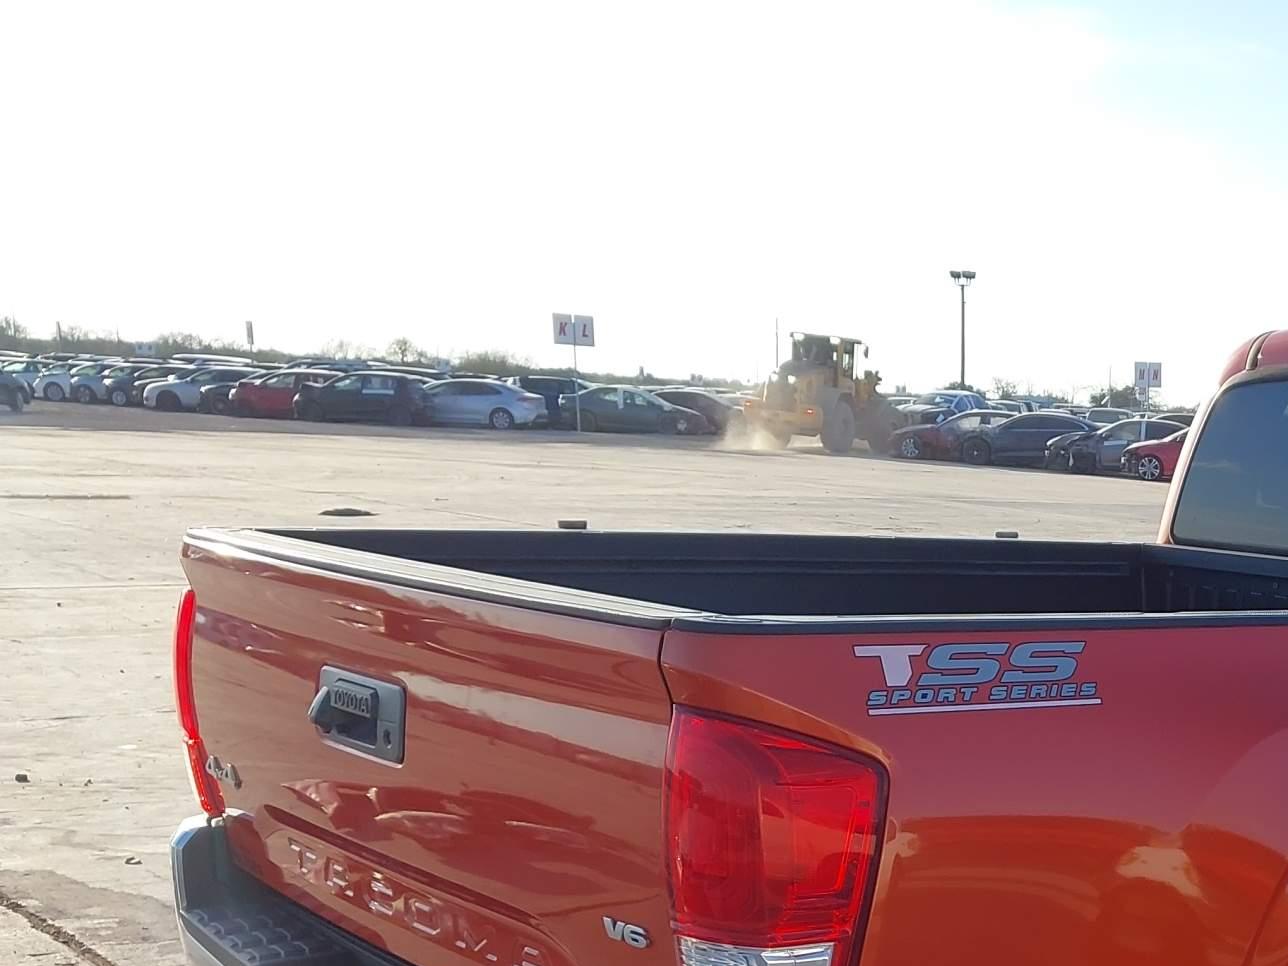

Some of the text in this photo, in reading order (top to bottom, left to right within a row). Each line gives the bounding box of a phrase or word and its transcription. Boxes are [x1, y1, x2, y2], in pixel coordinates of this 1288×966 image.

[559, 322, 589, 337] K L
[1152, 369, 1159, 381] N
[853, 641, 1087, 688] TSS
[331, 687, 370, 715] TOYOTA
[866, 682, 1097, 707] SPORT SERIES
[602, 916, 650, 949] V6
